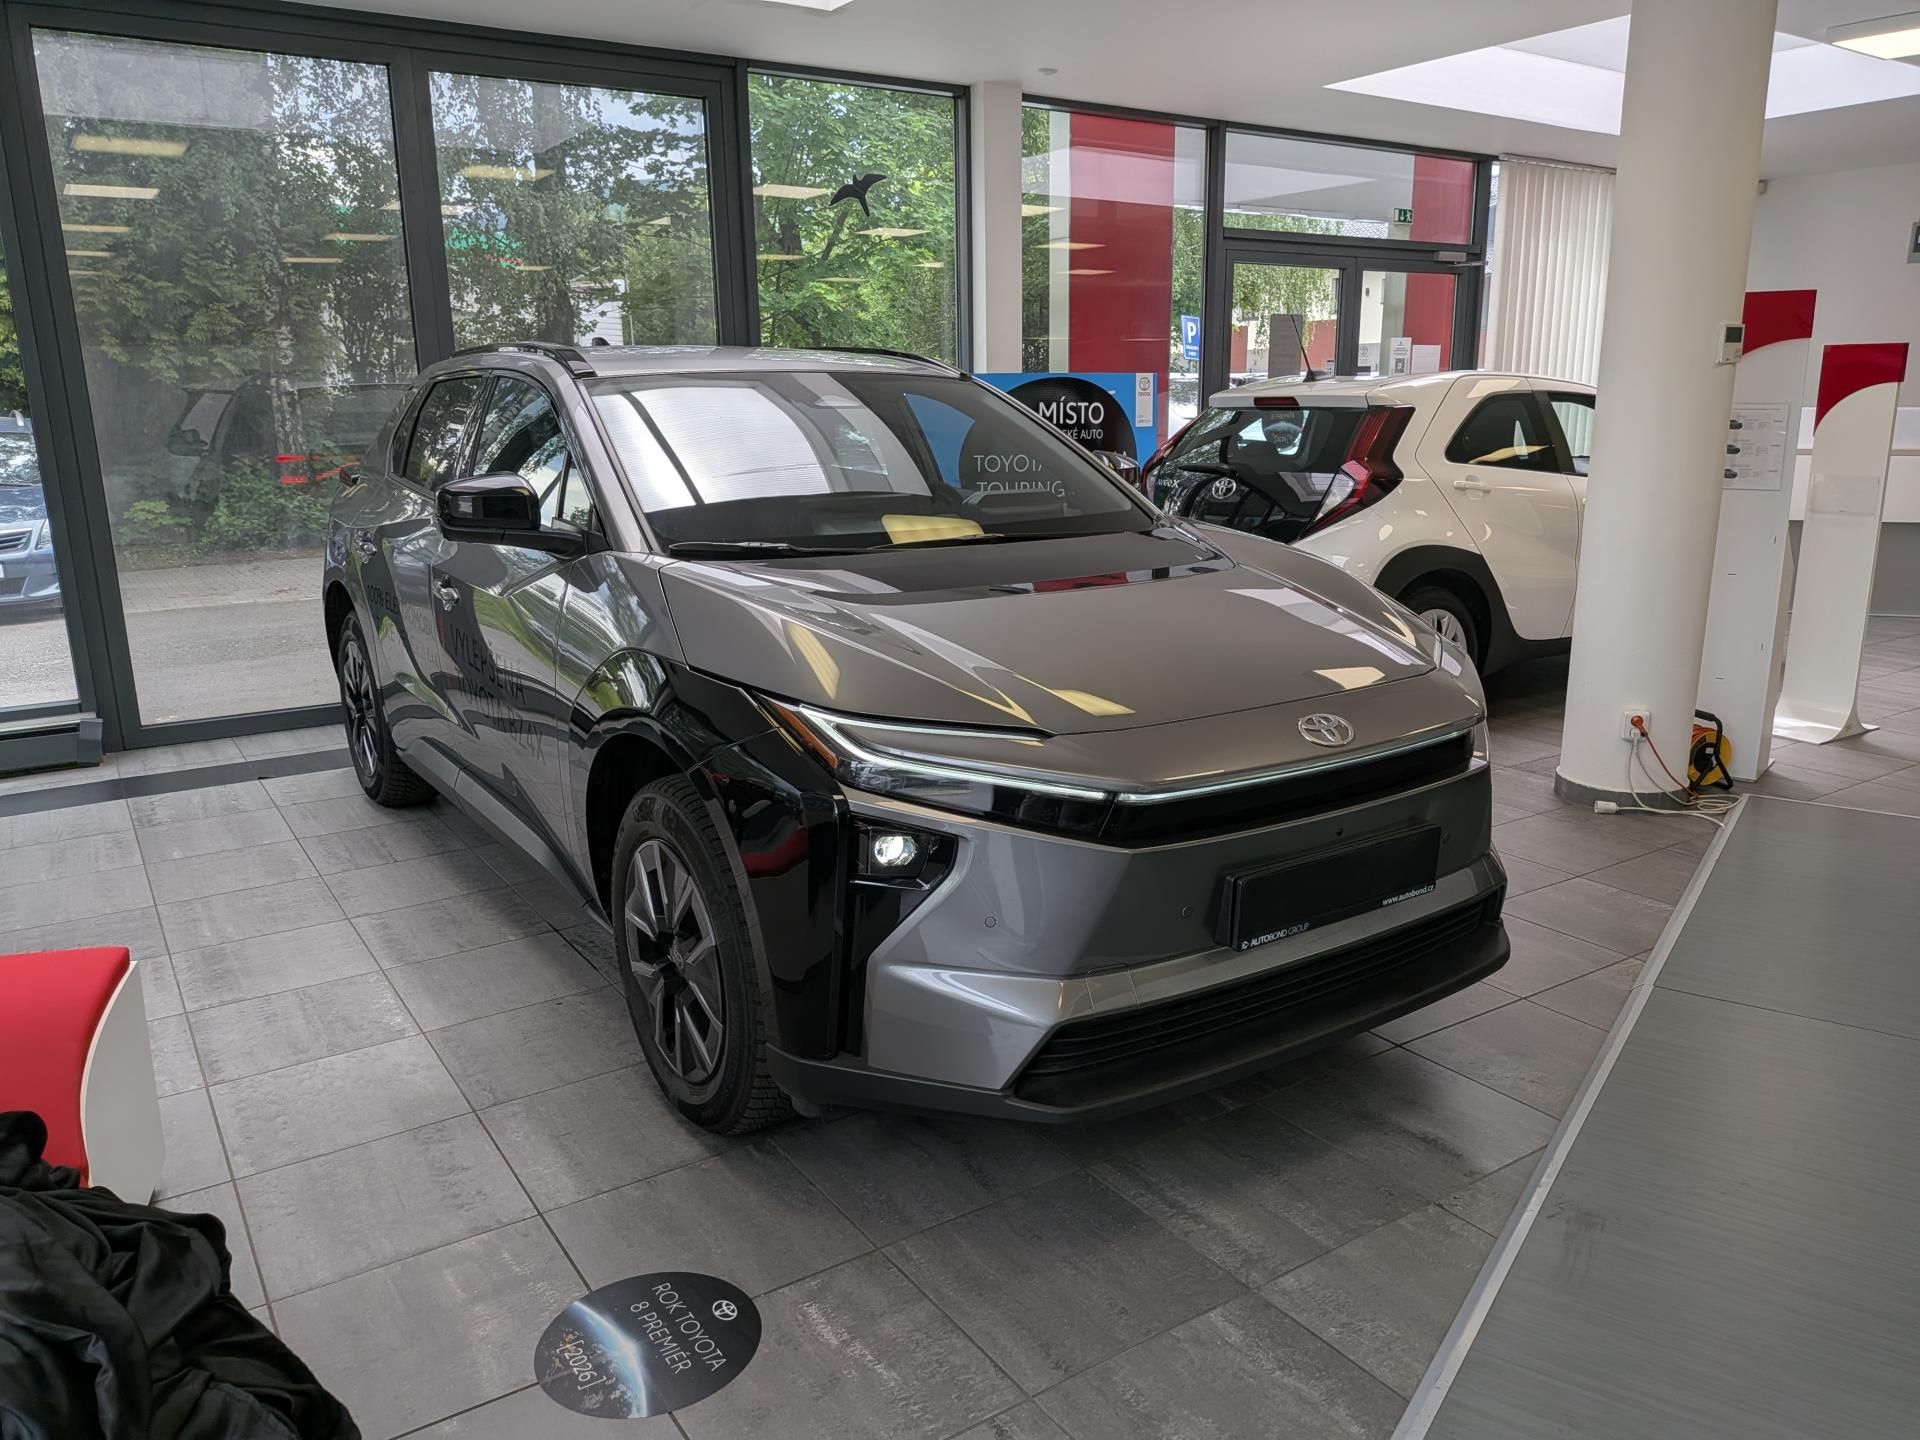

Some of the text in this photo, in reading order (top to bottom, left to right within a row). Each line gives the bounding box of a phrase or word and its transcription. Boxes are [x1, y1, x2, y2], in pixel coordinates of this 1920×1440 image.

[1187, 321, 1197, 343] P
[1038, 396, 1105, 425] MÍSTO
[1080, 429, 1104, 440] AUTO
[972, 454, 1043, 473] TOYO
[1382, 884, 1435, 906] www.autobond.cz
[1250, 921, 1310, 948] AUTOBOND GROUP
[630, 1301, 693, 1375] 8 PREMIÉR
[651, 1282, 728, 1372] ROK TOYOTA
